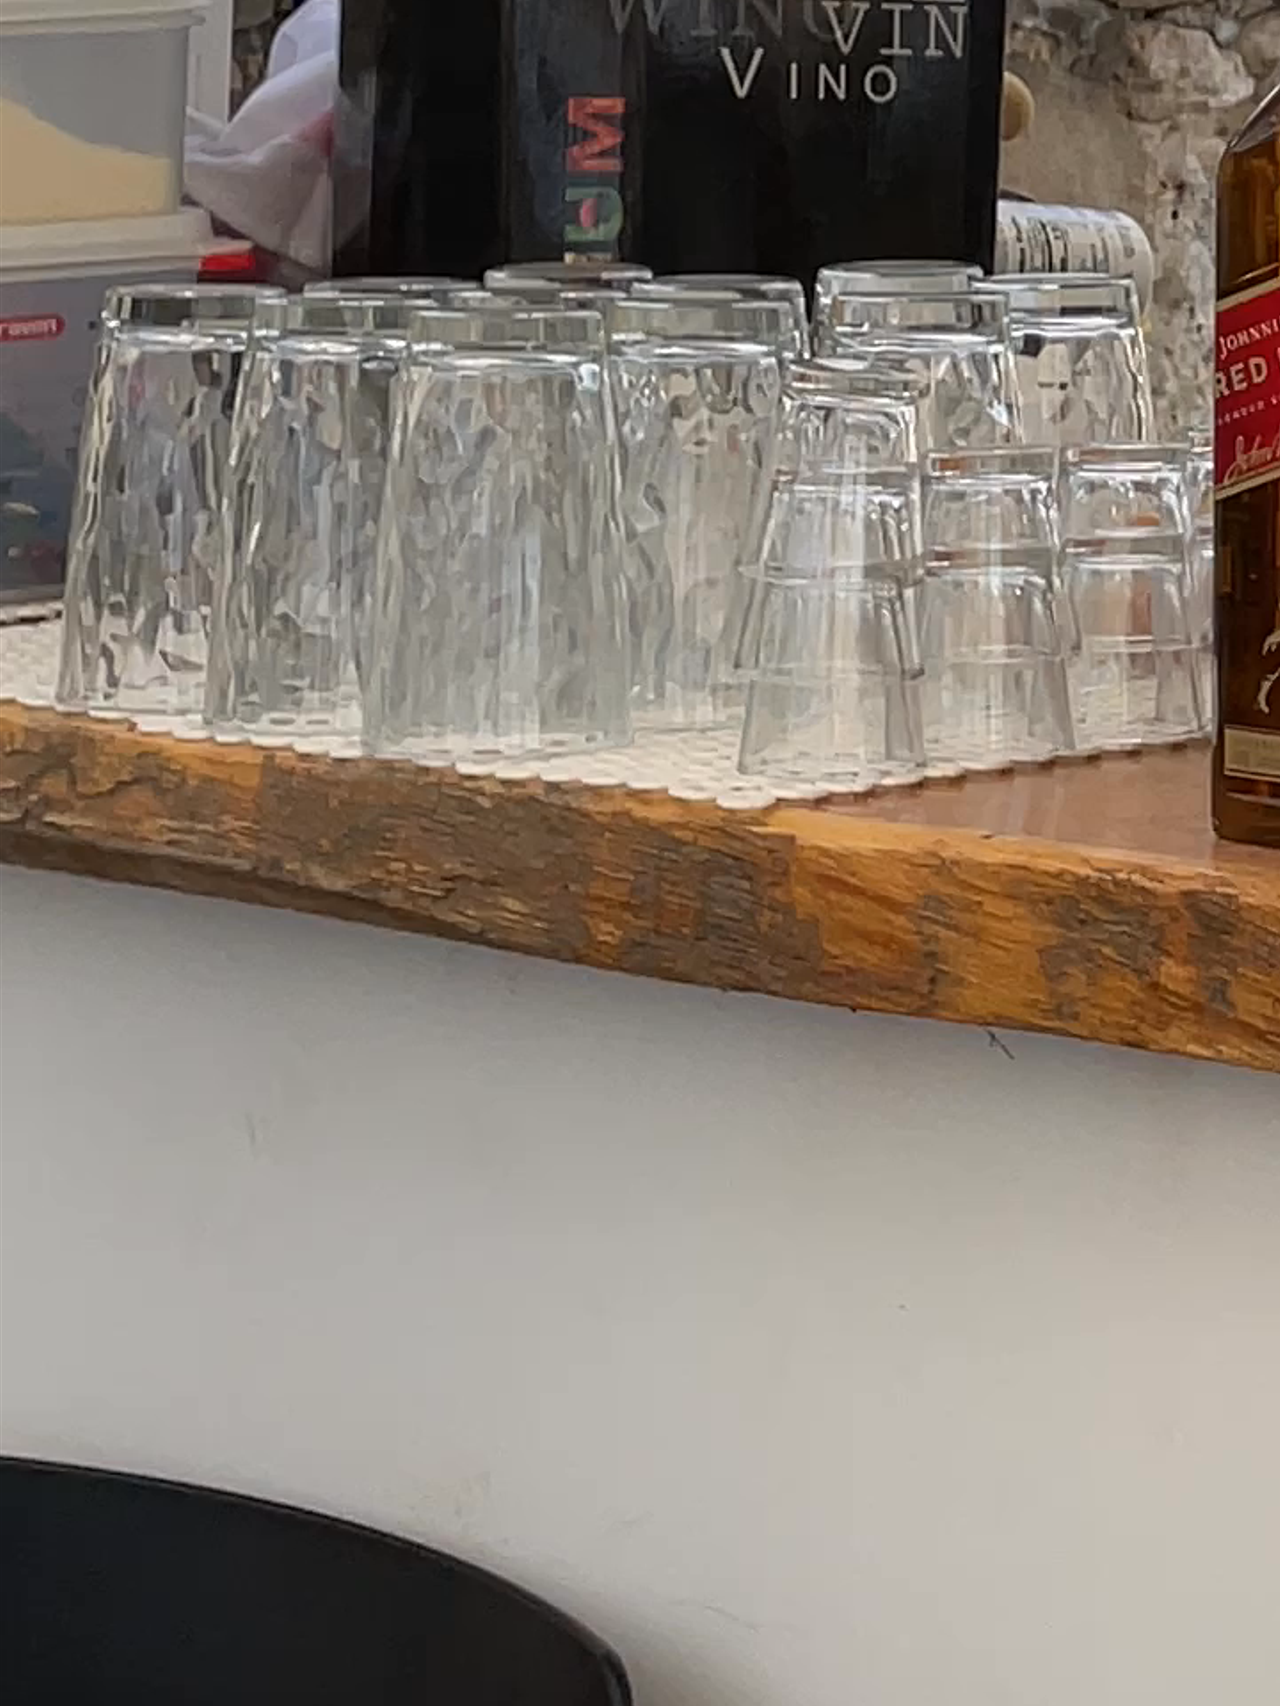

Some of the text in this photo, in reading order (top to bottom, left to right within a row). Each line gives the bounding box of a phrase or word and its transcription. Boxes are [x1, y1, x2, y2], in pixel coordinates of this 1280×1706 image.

[820, 0, 969, 59] VIN
[719, 45, 898, 105] VINO
[1215, 356, 1269, 399] RED
